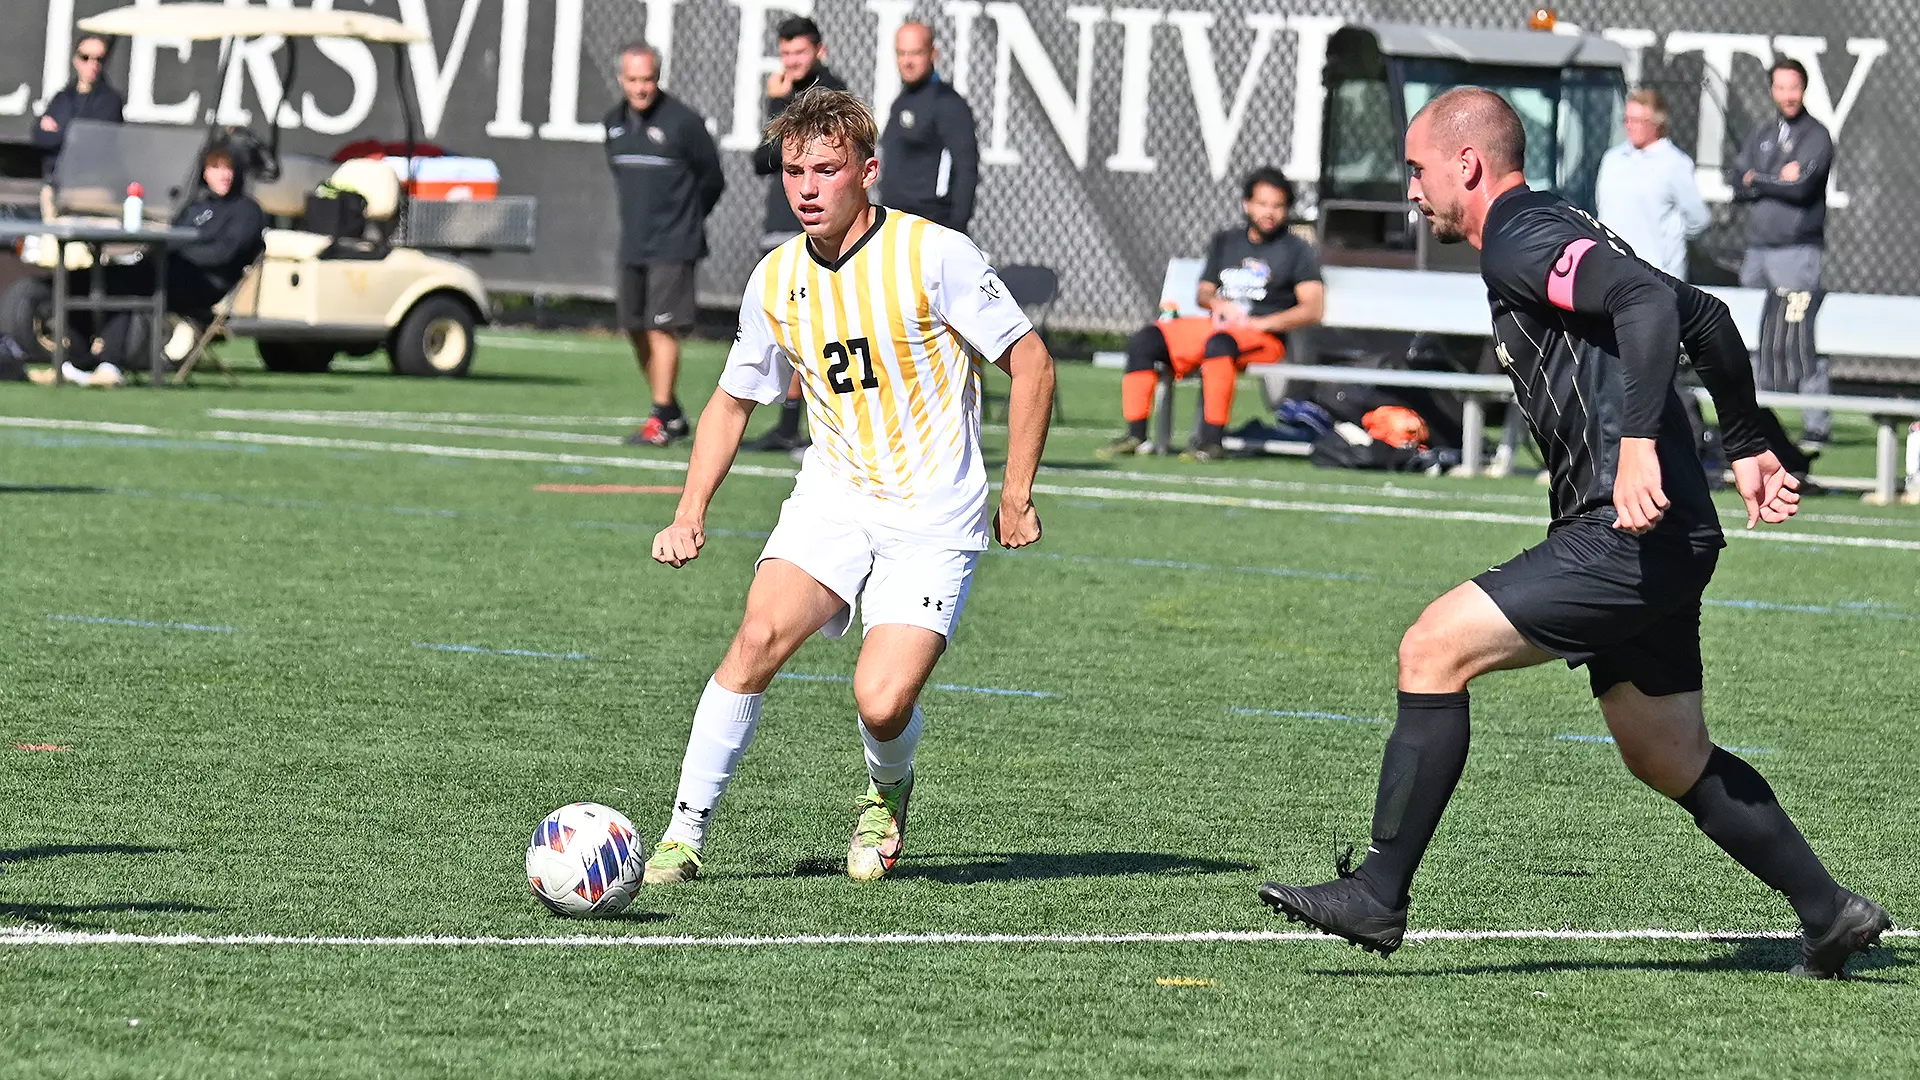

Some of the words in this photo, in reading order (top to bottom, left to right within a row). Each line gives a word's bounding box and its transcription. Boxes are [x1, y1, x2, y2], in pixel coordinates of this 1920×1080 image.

[0, 0, 815, 150] LERSVILE
[865, 0, 1888, 208] UNIVEITY
[823, 337, 879, 394] 27
